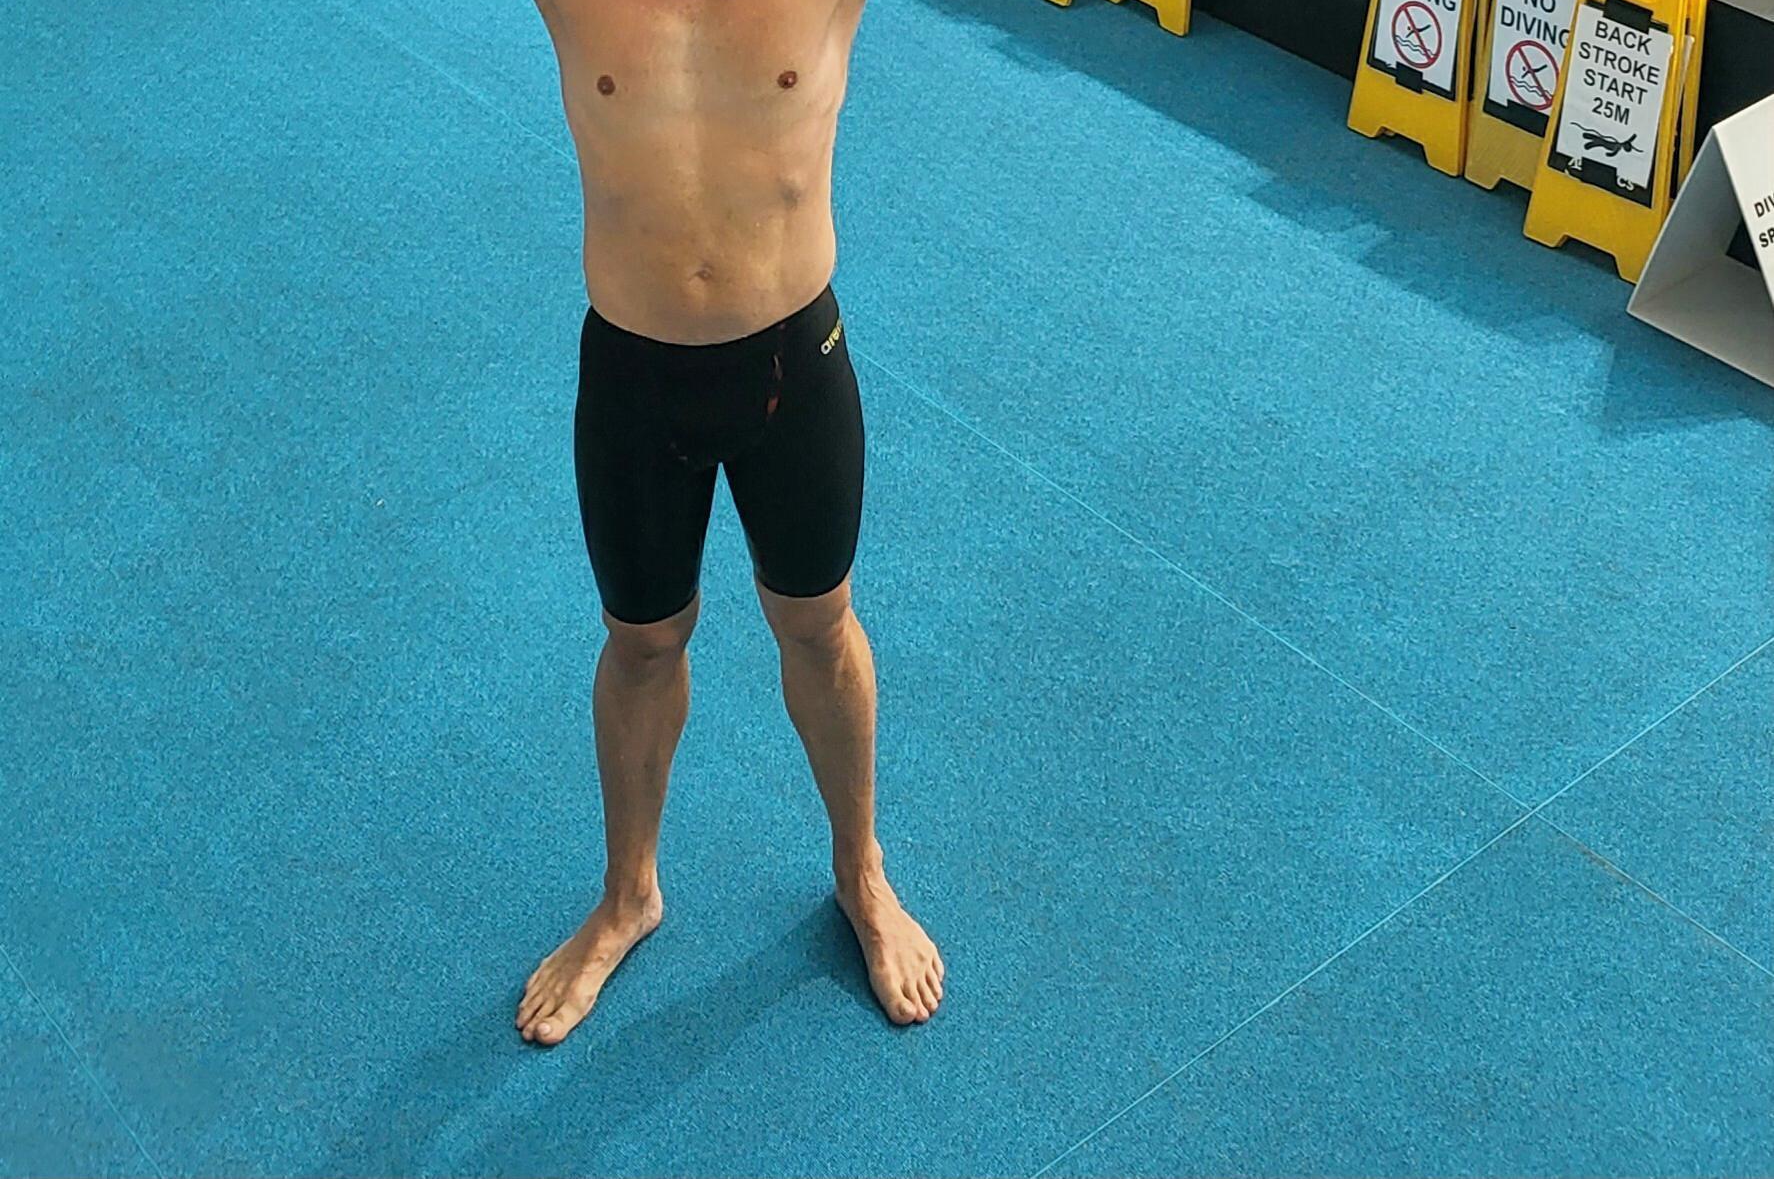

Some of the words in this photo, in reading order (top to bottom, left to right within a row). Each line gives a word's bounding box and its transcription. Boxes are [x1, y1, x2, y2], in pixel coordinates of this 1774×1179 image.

[1594, 20, 1652, 55] BACK
[1578, 41, 1660, 86] STROKE
[1583, 68, 1648, 105] START
[1591, 97, 1630, 126] 25M
